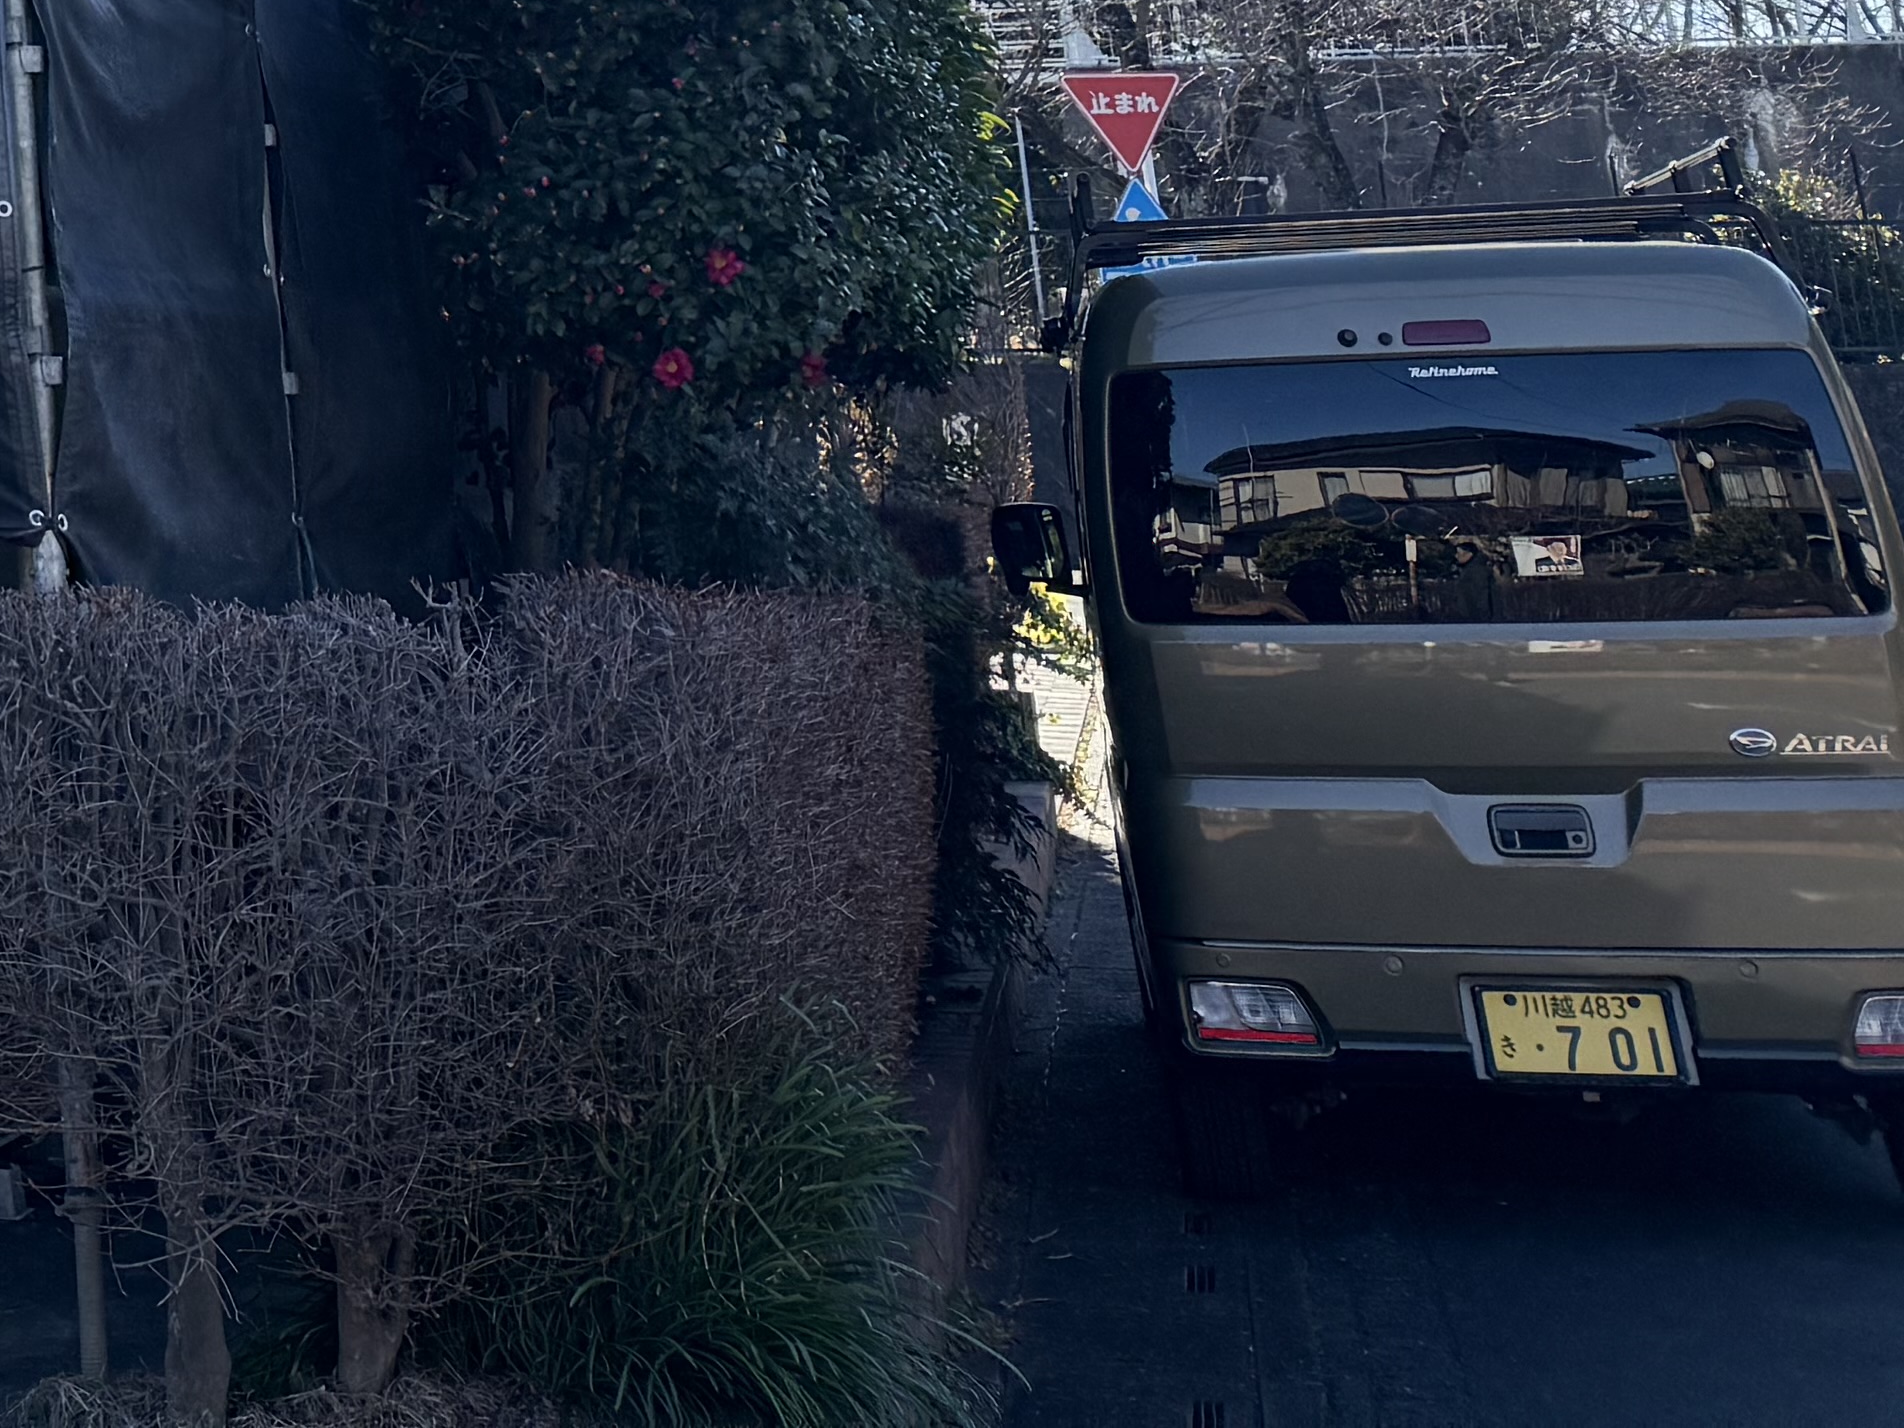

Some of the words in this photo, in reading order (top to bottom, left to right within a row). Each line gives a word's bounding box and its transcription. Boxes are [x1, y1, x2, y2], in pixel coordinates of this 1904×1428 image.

[1090, 92, 1160, 115] 止まれ
[1783, 732, 1889, 753] ATRAI
